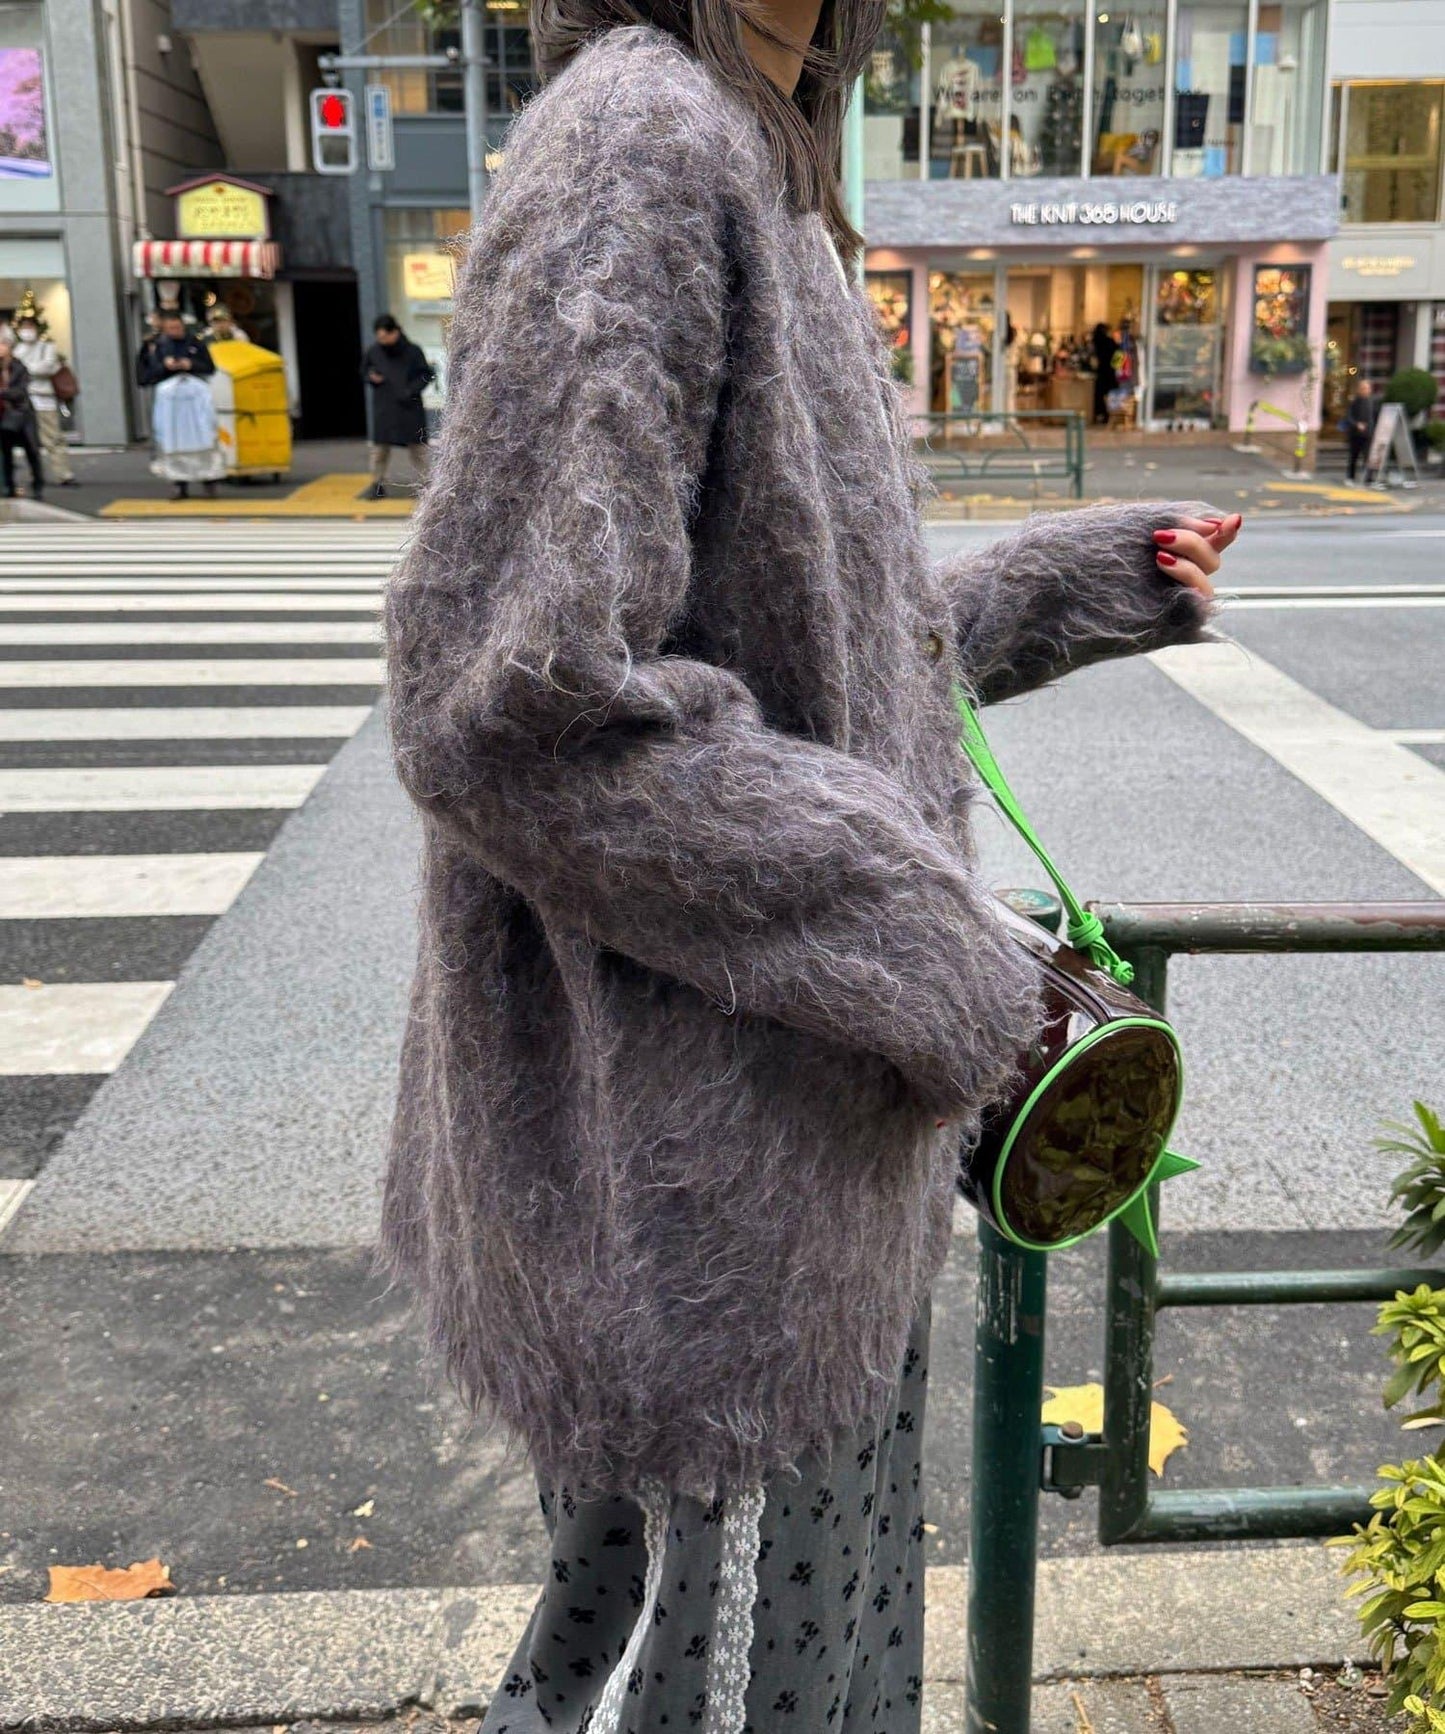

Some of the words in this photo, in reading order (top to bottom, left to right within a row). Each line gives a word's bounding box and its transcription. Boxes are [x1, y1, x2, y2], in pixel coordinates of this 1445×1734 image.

[1013, 91, 1038, 103] on
[1011, 203, 1038, 223] THE
[1040, 203, 1078, 223] KNT
[1078, 202, 1118, 224] 365
[1119, 201, 1178, 223] HOUSE
